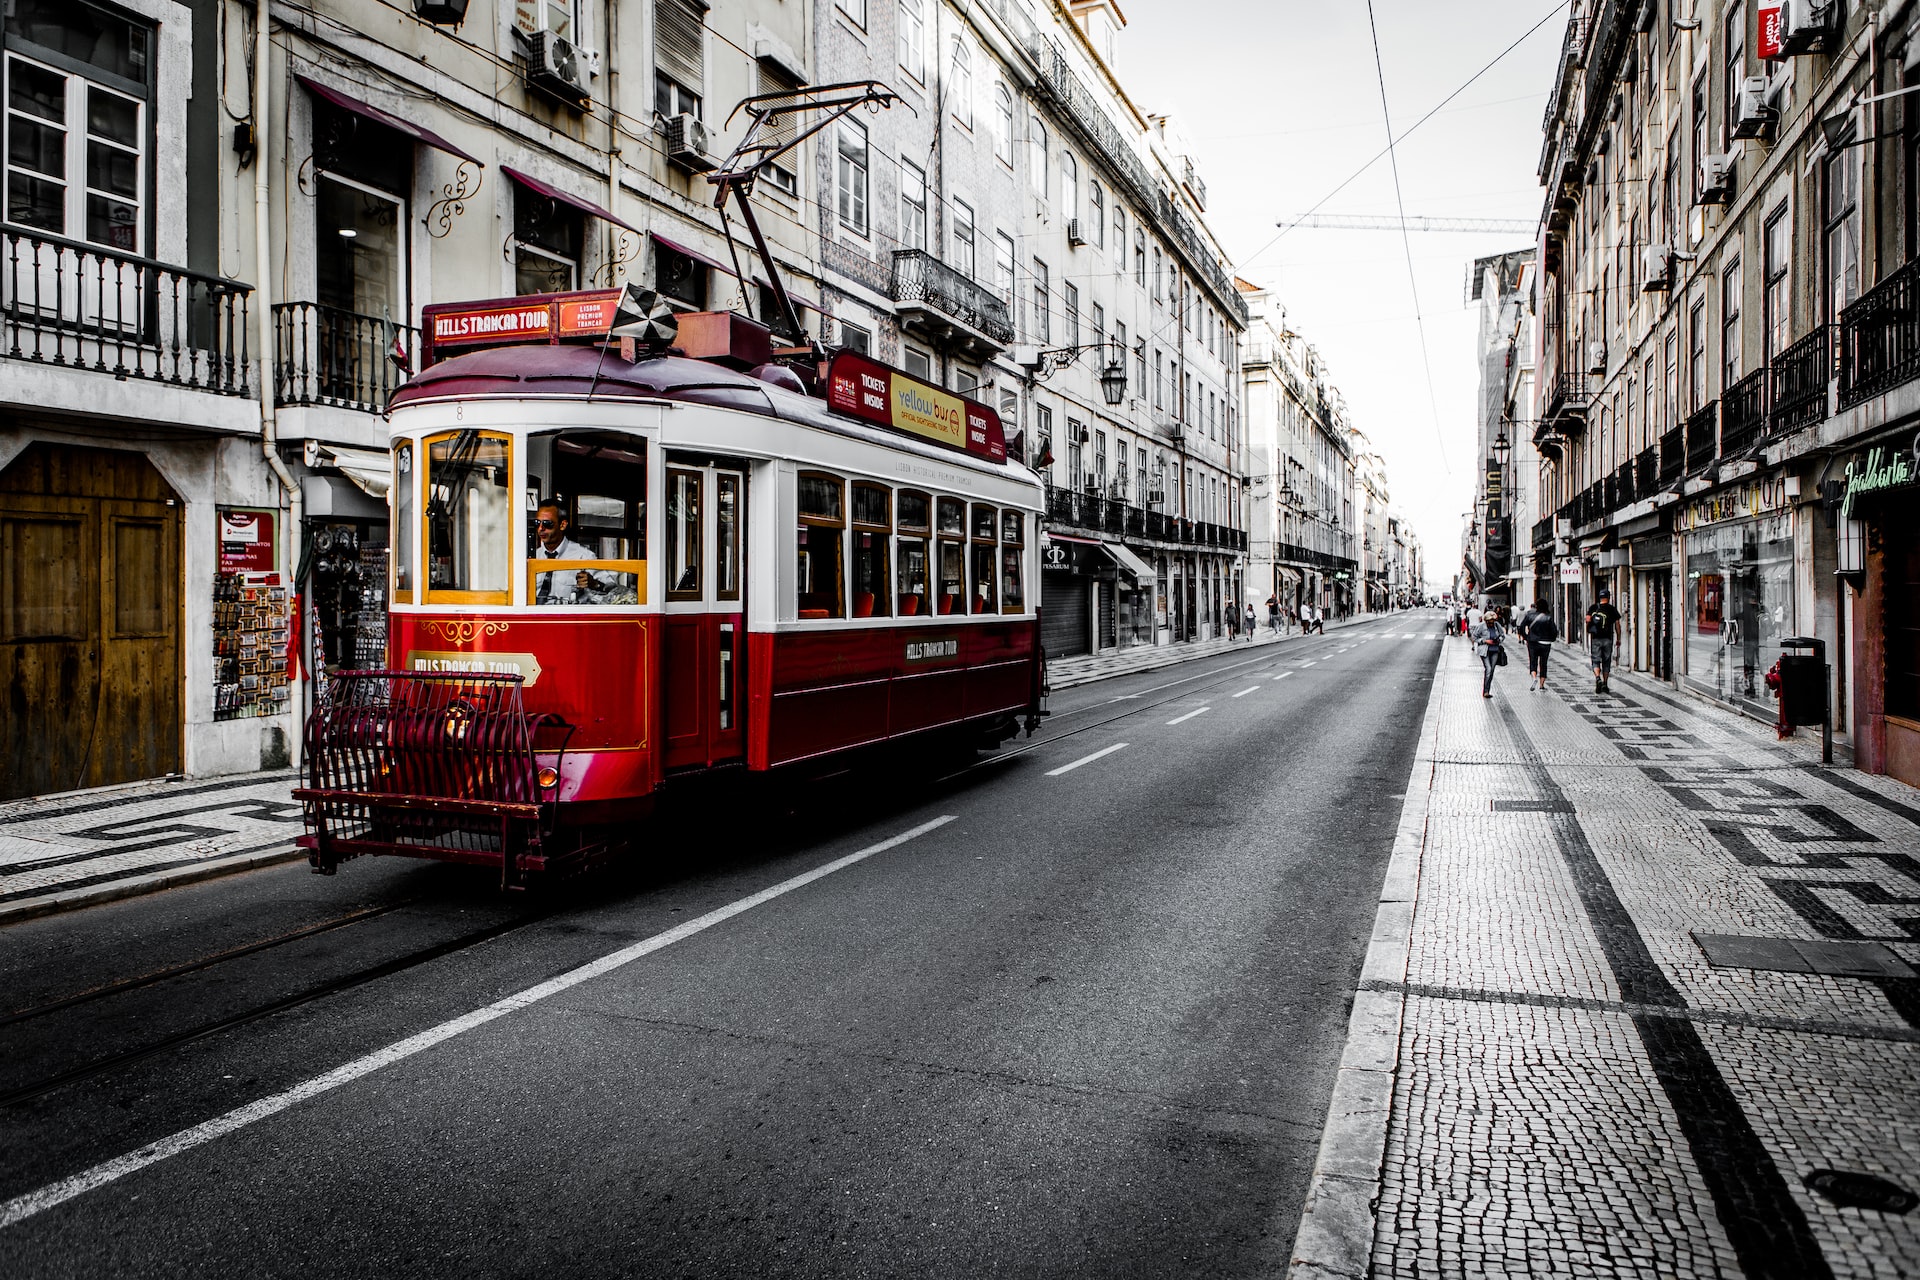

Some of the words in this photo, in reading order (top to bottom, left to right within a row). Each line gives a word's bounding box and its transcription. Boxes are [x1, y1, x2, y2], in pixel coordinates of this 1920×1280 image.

[517, 7, 530, 20] OURO
[518, 19, 535, 32] PRATA
[580, 304, 601, 312] LISBON
[436, 317, 469, 336] HILLS
[470, 313, 518, 333] TRAMCAR
[519, 310, 549, 329] TOUR
[577, 312, 603, 320] PREMIUM
[577, 319, 603, 328] TRAMCAR
[861, 373, 886, 394] TICKETS
[864, 392, 884, 410] INSIDE
[457, 406, 463, 420] 8
[933, 397, 949, 422] bus
[969, 415, 987, 430] TICKETS
[971, 430, 986, 444] INSIDE
[907, 643, 923, 659] HILLS
[945, 640, 957, 655] TOUR
